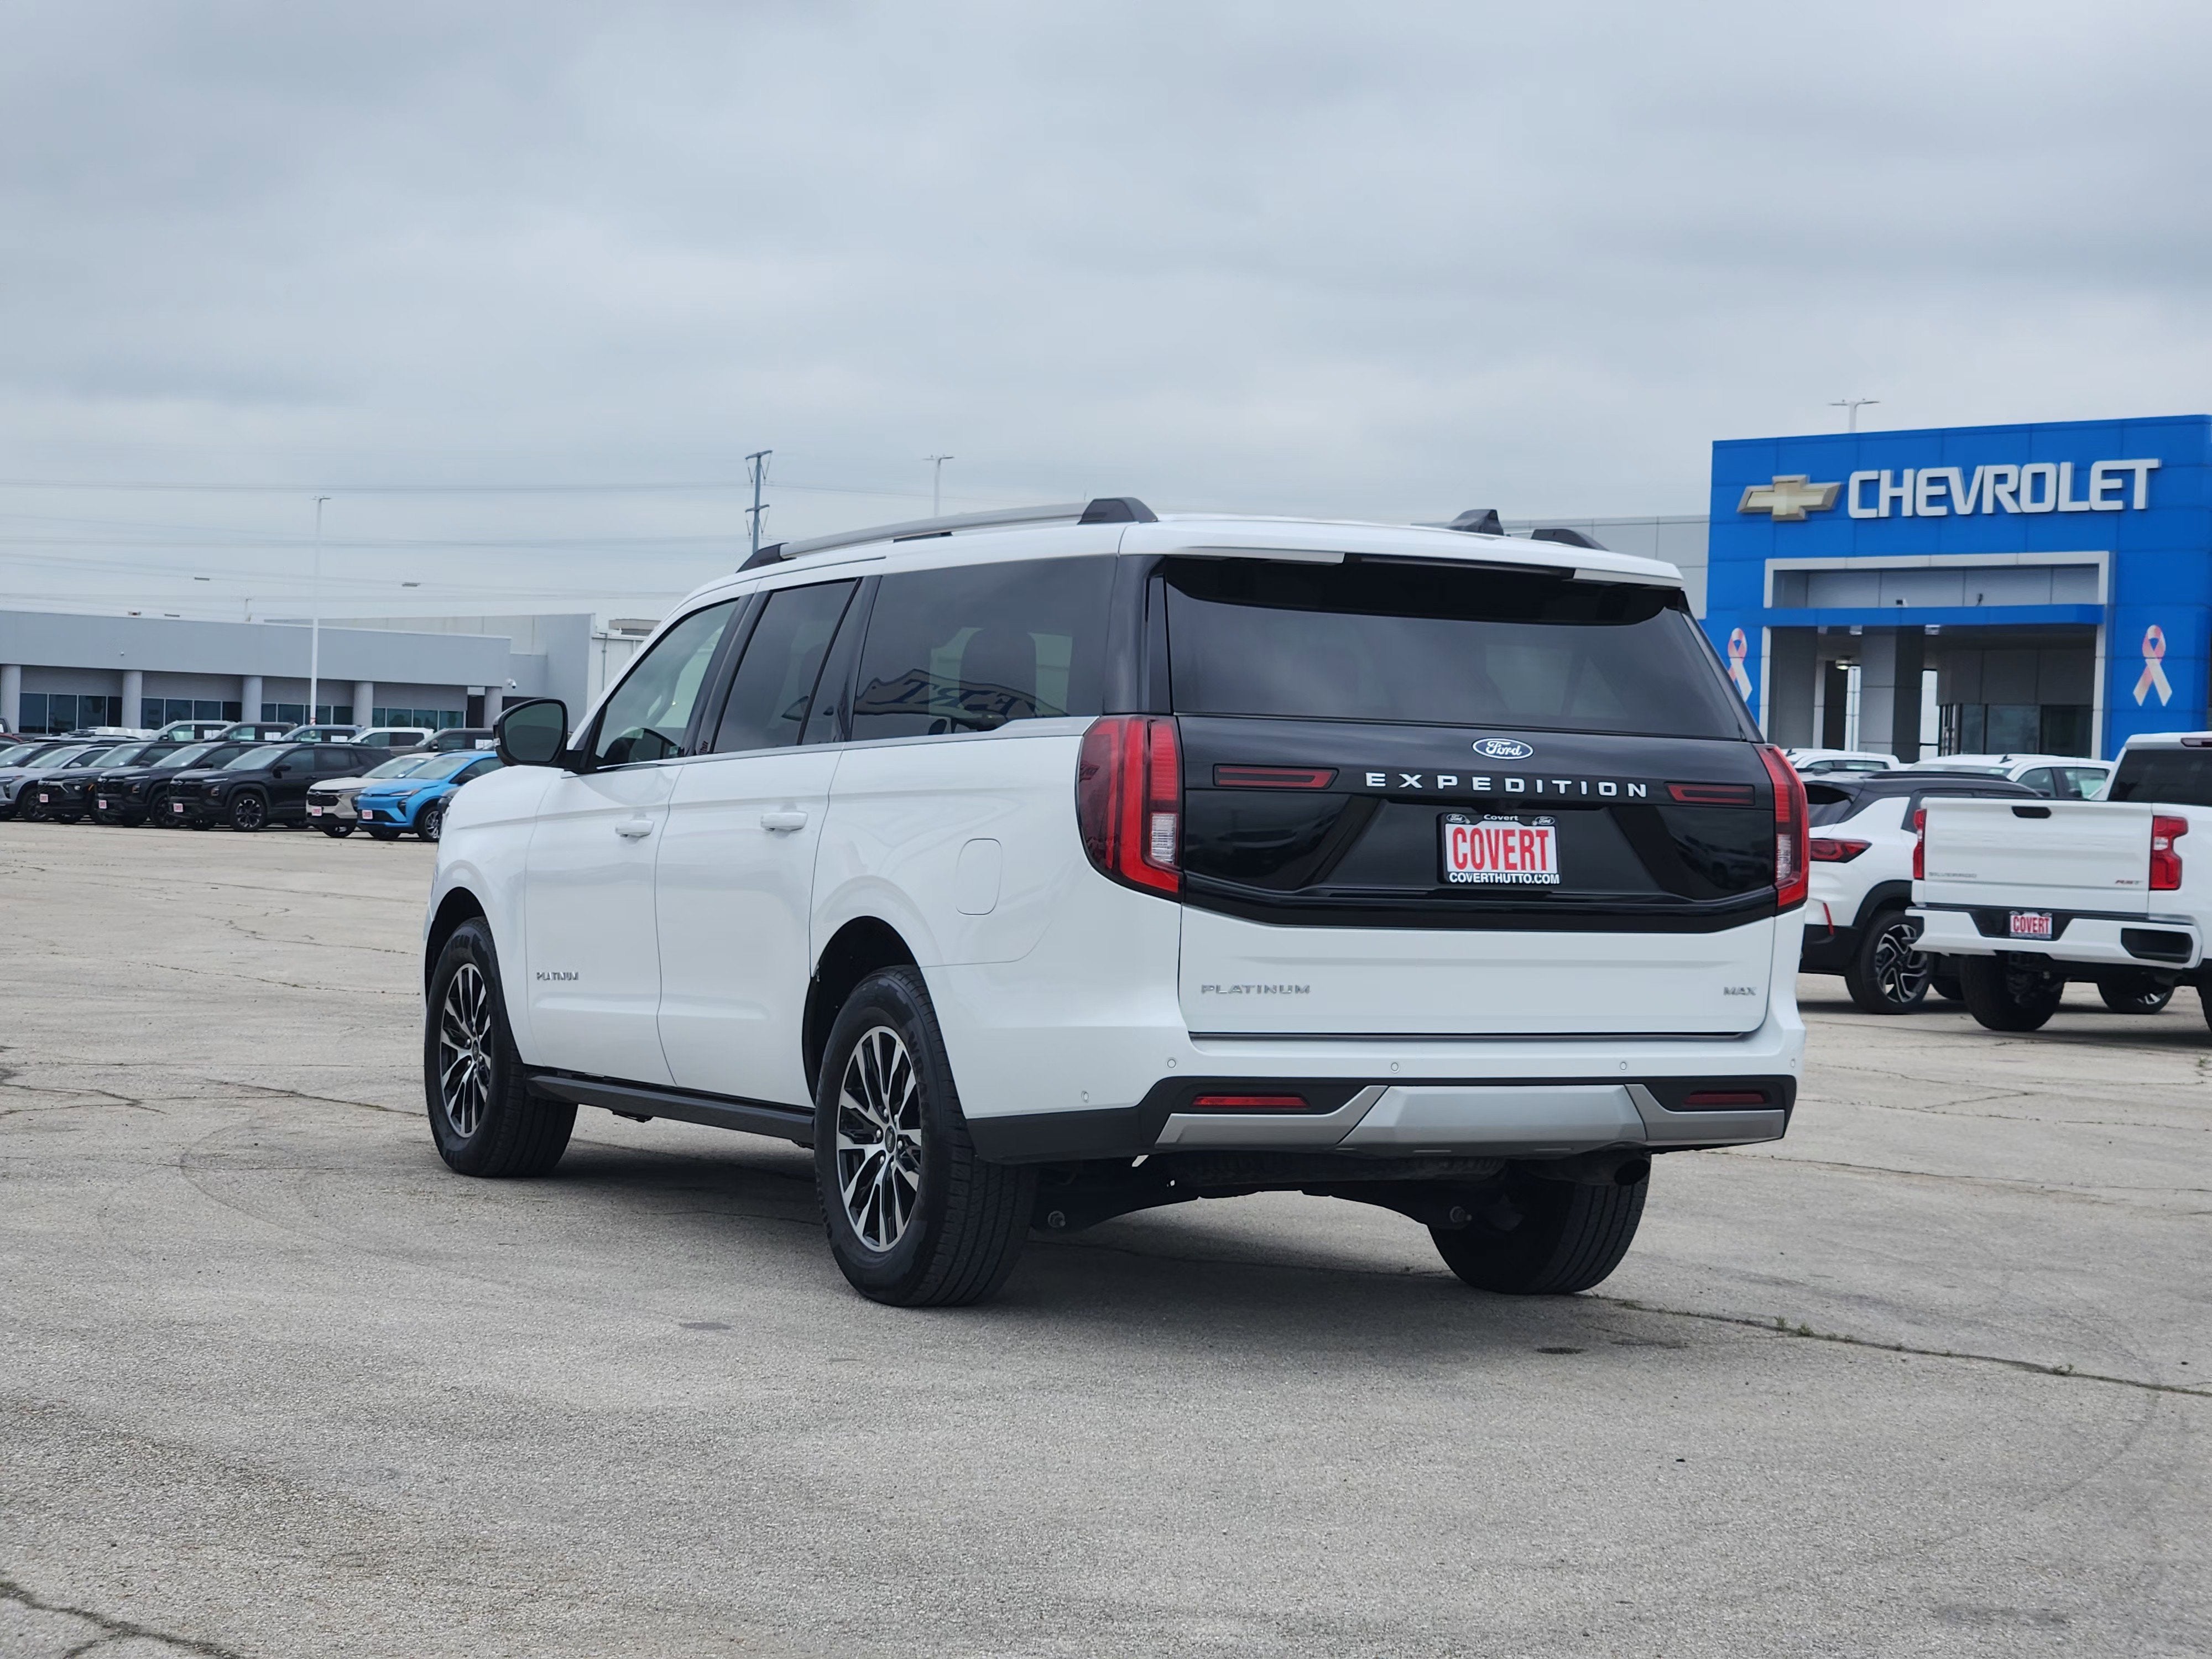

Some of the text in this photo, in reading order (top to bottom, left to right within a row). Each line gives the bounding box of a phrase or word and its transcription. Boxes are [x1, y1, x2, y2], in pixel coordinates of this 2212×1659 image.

[1849, 458, 2161, 518] CHEVROLET
[1365, 773, 1646, 797] EXPEDITION
[1453, 827, 1548, 870] COVERT
[1449, 873, 1559, 884] COVERTHUTTO.COM
[2013, 916, 2049, 933] COVERT
[536, 972, 579, 980] PLATINUM
[1201, 984, 1310, 994] PLATINUM
[1723, 987, 1756, 995] MAX
